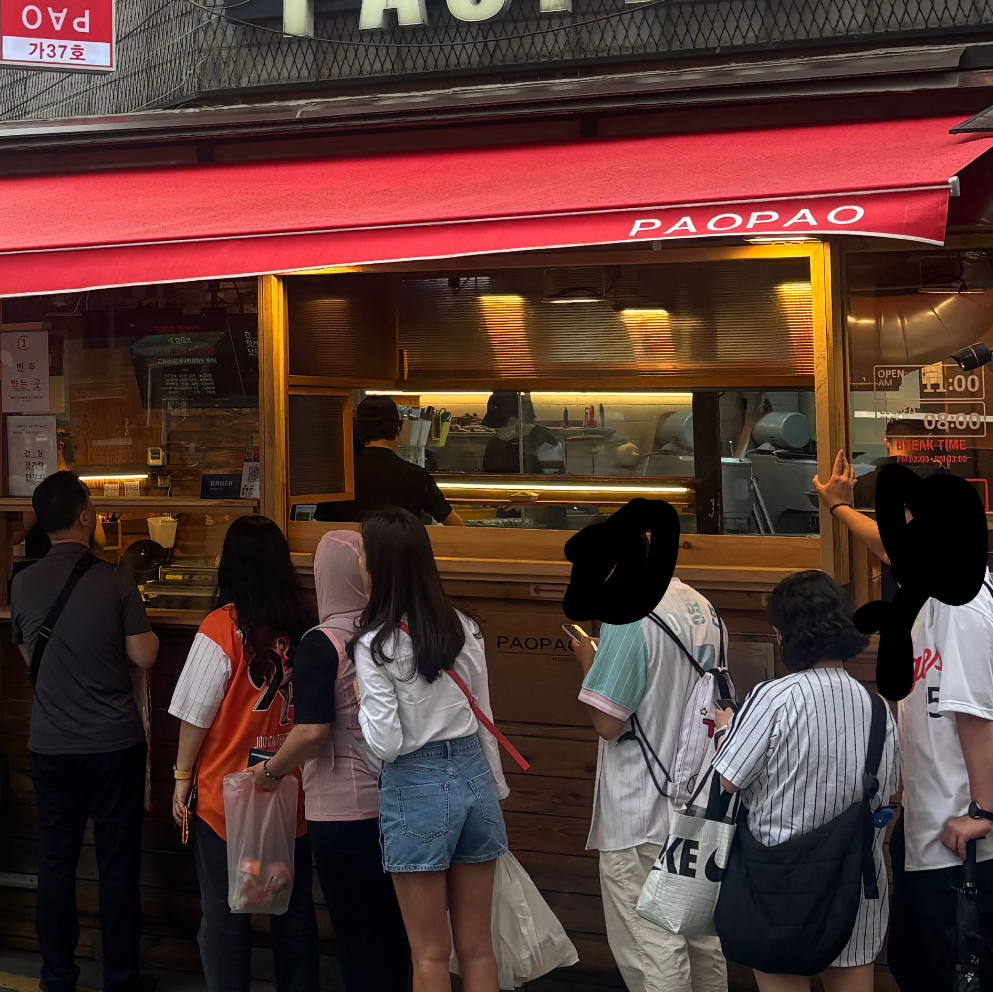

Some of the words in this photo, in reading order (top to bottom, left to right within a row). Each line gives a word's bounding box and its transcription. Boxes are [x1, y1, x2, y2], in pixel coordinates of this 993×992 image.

[28, 43, 86, 61] 가37호
[629, 205, 864, 236] PAOPAO
[877, 369, 904, 379] OPEN
[878, 379, 893, 387] AM
[923, 412, 981, 430] 08:00
[896, 439, 934, 451] BREAK
[937, 439, 967, 451] TIME
